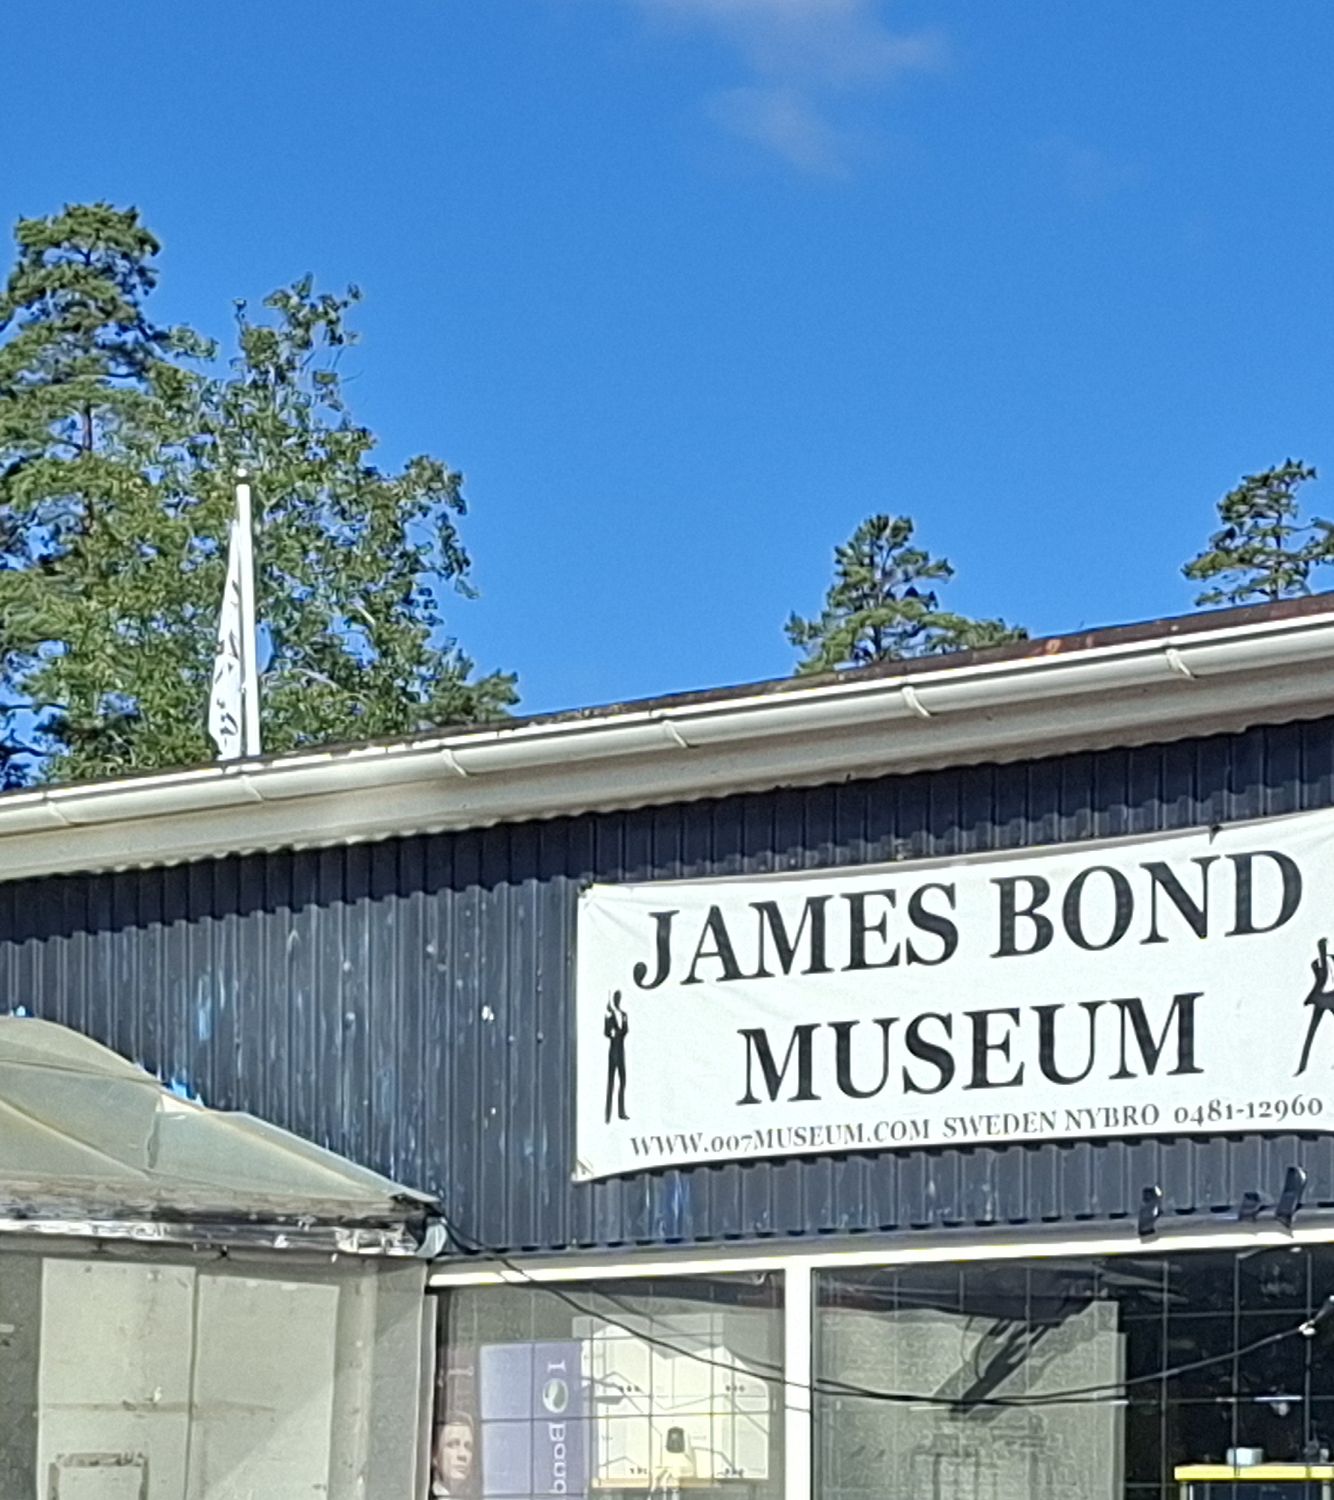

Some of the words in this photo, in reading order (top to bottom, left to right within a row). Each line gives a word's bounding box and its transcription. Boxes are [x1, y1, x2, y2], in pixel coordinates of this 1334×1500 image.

[633, 883, 959, 989] JAMES
[990, 850, 1304, 961] BOND
[737, 992, 1205, 1106] MUSEUM
[630, 1118, 931, 1157] WWW.007MUSEUM.COM
[942, 1110, 1058, 1140] SWEDEN
[1064, 1103, 1160, 1132] NYBRO
[1173, 1094, 1323, 1128] 0481-12960
